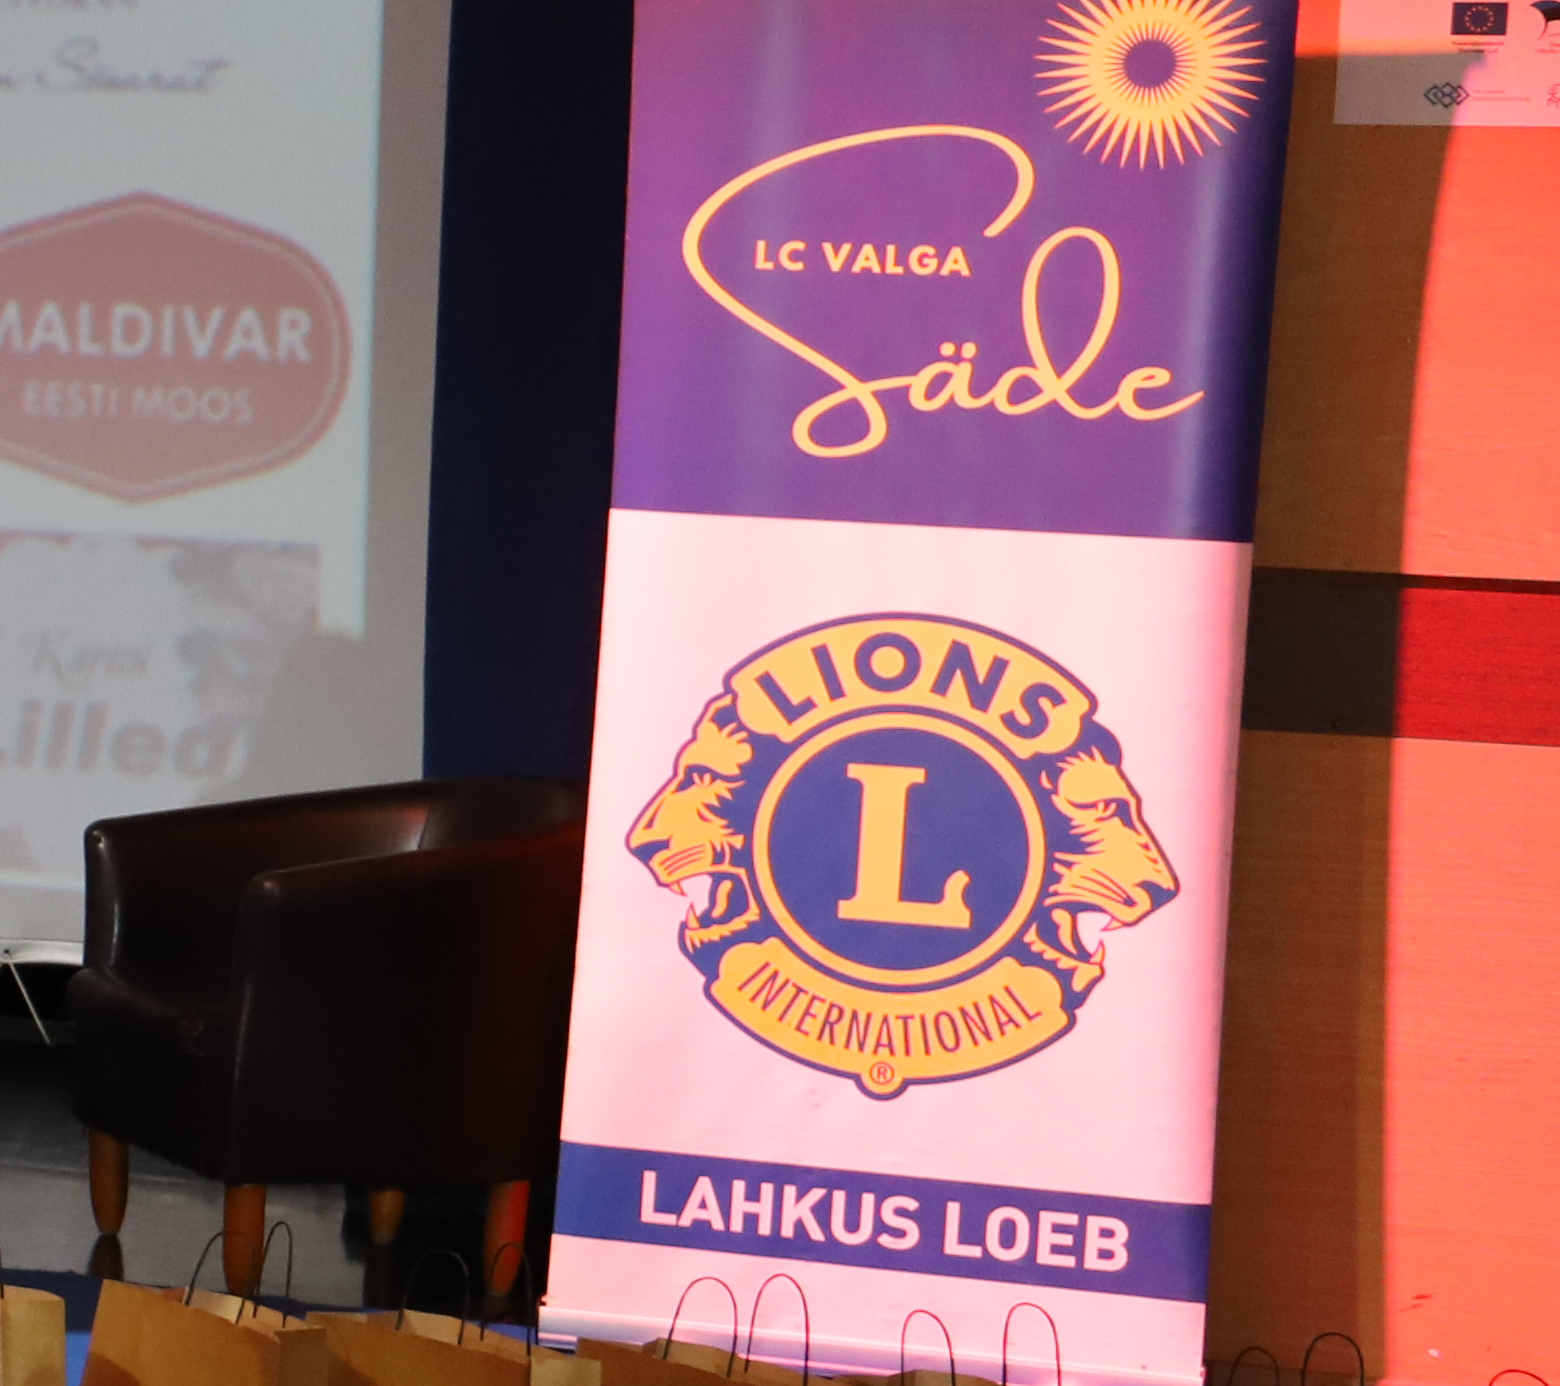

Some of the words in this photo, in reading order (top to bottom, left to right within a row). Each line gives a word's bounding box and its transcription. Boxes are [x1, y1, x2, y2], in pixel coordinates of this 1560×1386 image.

[682, 124, 1206, 458] Säde
[754, 239, 807, 273] LC
[822, 242, 971, 277] VALGA
[20, 379, 120, 421] EESTI
[131, 385, 254, 427] MOOS
[755, 631, 1066, 759] LIONS
[836, 763, 972, 929] L
[736, 961, 1043, 1059] INTERNATIONAL
[639, 1169, 922, 1253] LAHKUS
[942, 1201, 1132, 1275] LOEB
